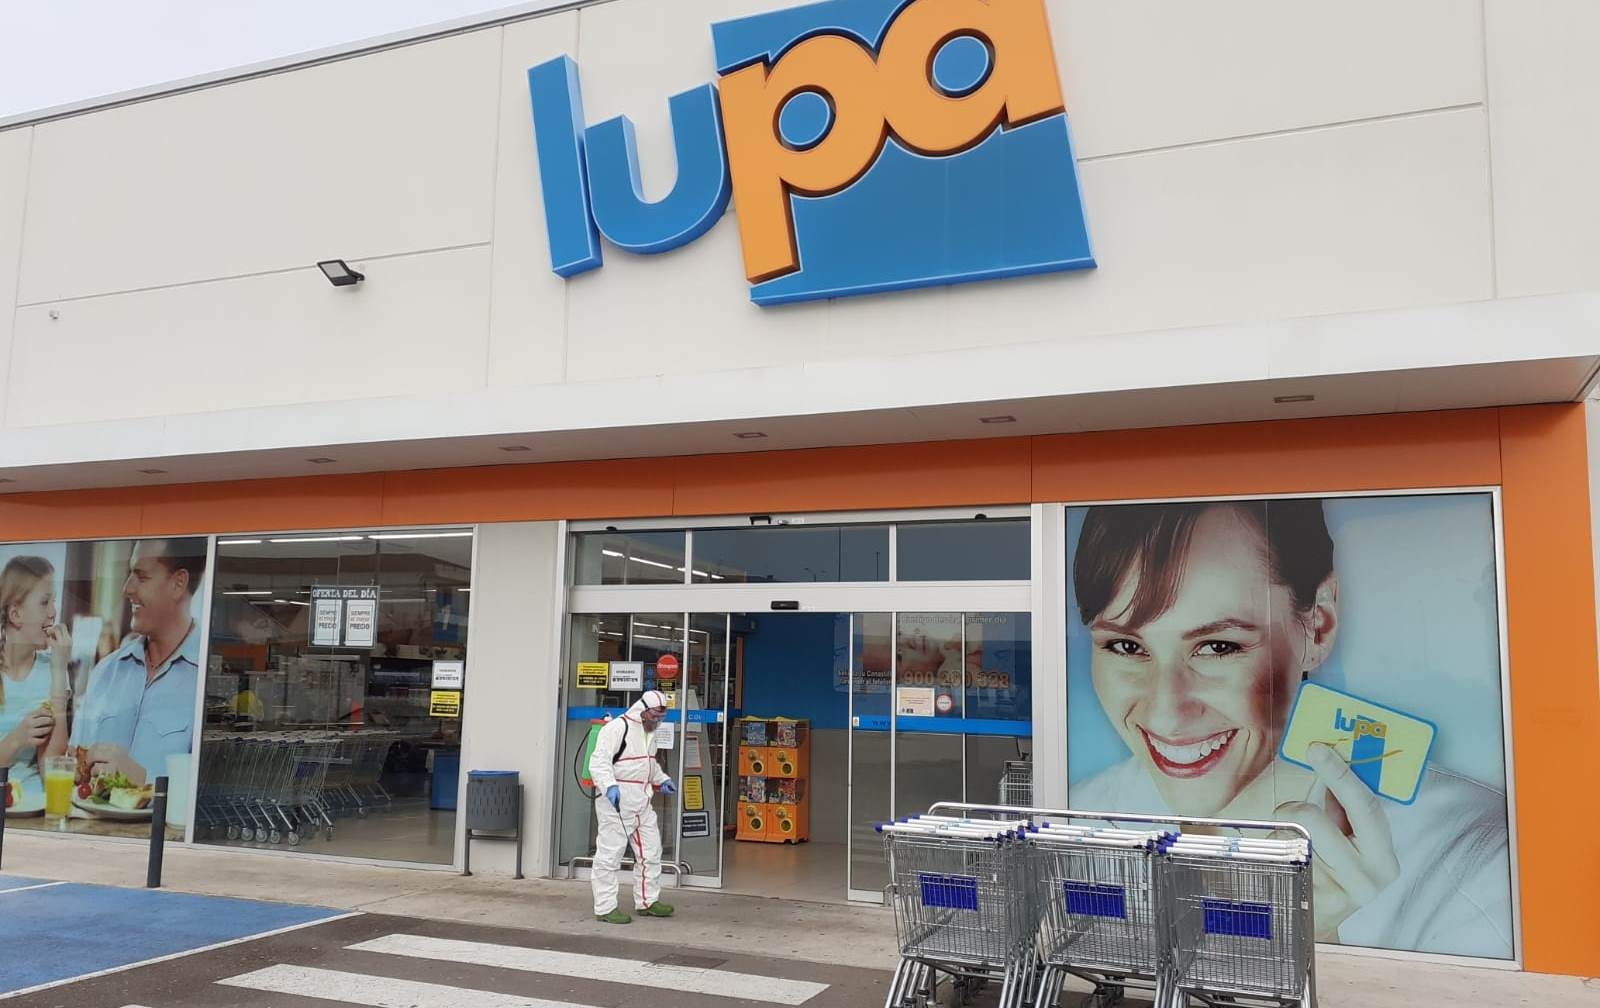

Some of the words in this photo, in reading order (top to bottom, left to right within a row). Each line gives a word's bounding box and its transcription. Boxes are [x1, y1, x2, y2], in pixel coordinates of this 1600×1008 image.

[527, 0, 1067, 285] lupa
[342, 589, 359, 598] DEL
[360, 588, 377, 599] DÍA
[1334, 707, 1388, 740] lupa
